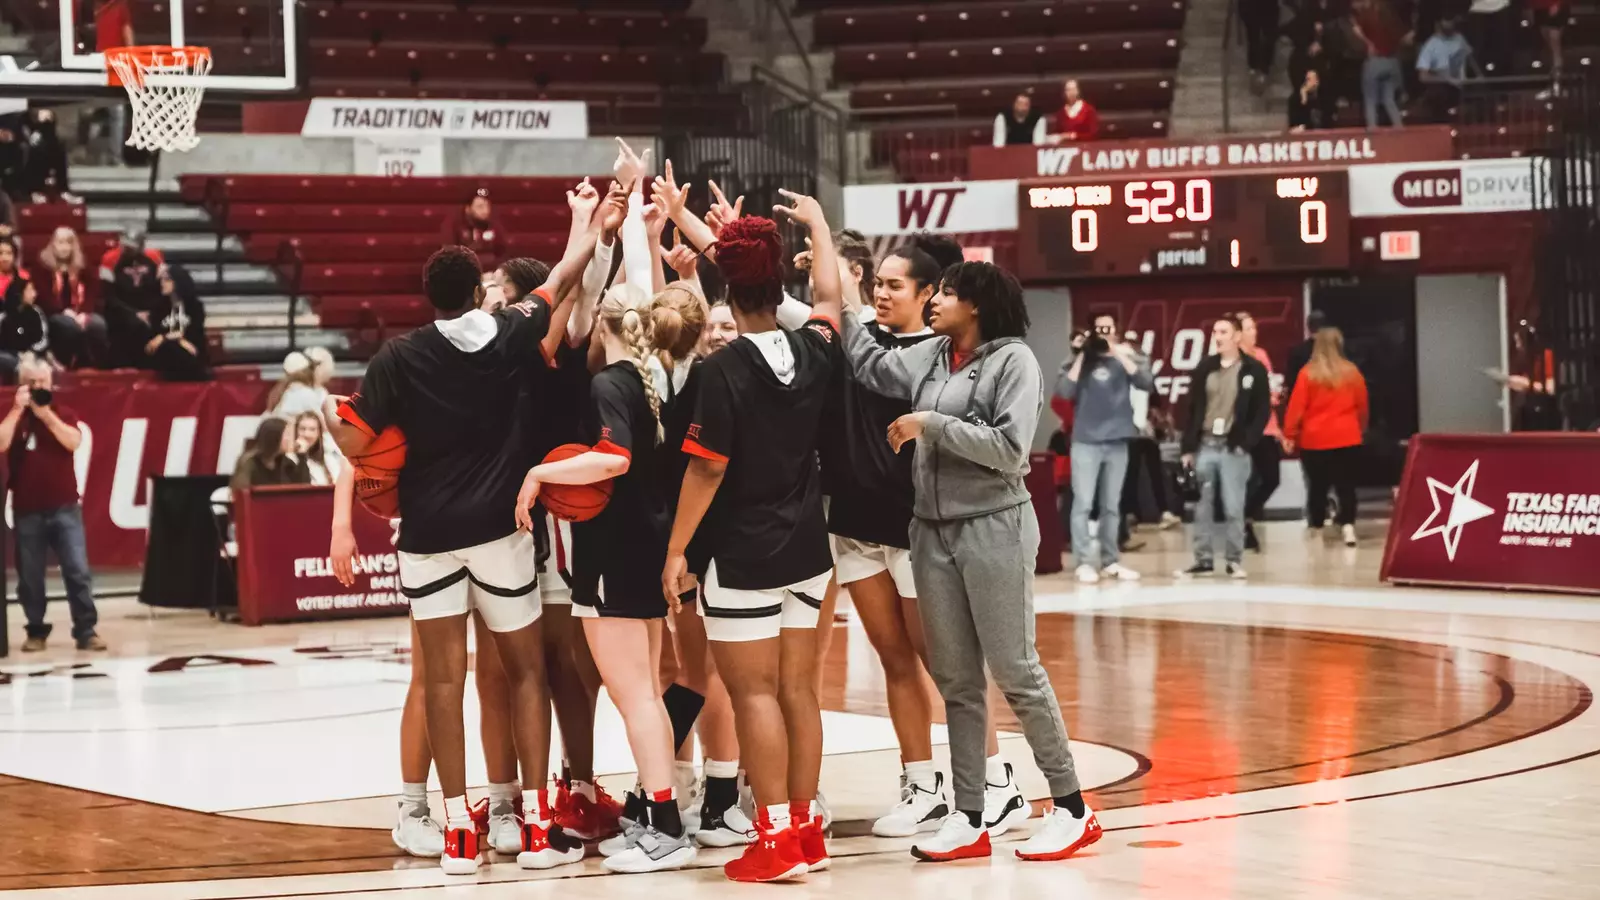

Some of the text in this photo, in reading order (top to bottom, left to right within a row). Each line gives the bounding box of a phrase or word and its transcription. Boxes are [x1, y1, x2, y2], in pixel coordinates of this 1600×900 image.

[331, 107, 444, 129] TRADITION
[471, 109, 552, 129] MOTION
[1037, 137, 1377, 176] WT LADY BUFFS BASKETBALL
[1124, 178, 1212, 224] 52.0
[1402, 178, 1459, 198] MEDI
[898, 187, 968, 229] WT
[1300, 200, 1327, 243] 0
[1071, 209, 1098, 252] 0
[1157, 245, 1207, 270] period
[1506, 492, 1564, 513] TEXAS
[296, 595, 334, 611] VOTED
